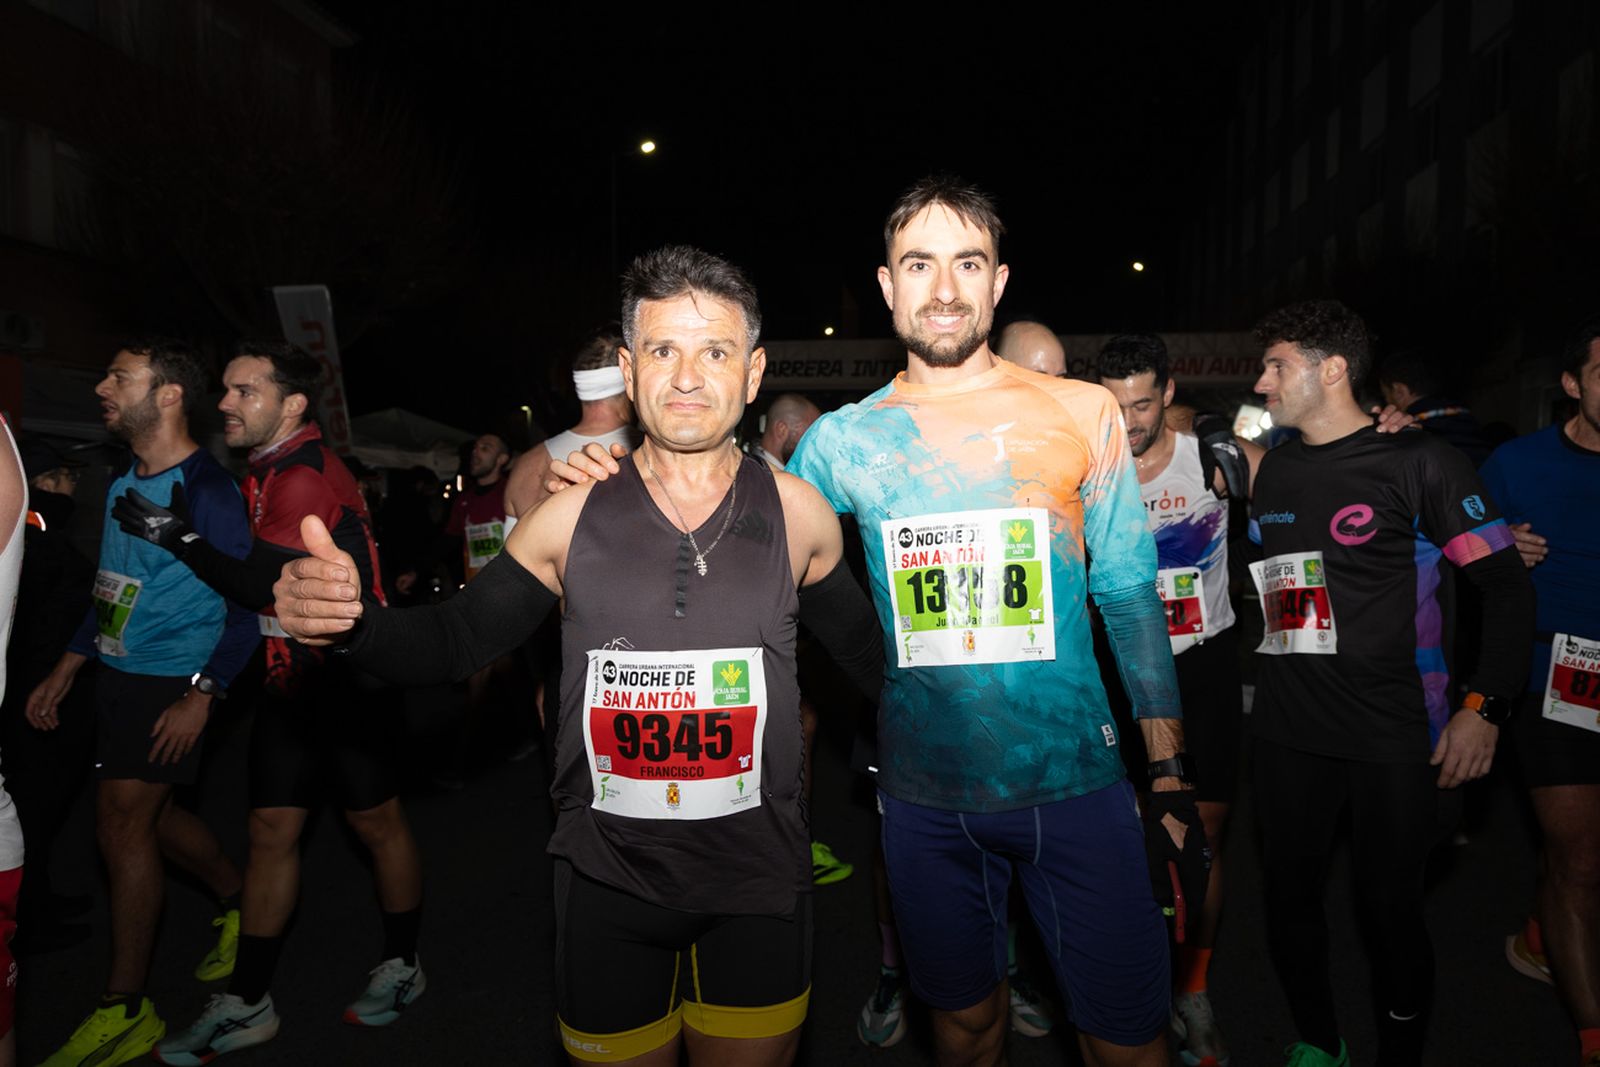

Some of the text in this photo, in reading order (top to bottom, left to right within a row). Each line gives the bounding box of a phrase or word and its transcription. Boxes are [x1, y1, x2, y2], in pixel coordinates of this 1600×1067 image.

[767, 360, 843, 377] ARRERA
[1207, 356, 1263, 375] ANT
[1144, 489, 1186, 512] rón
[899, 531, 913, 544] 43
[916, 530, 963, 548] NOCHE
[901, 550, 929, 569] SAN
[602, 665, 617, 678] 43
[1562, 656, 1586, 669] SAN
[618, 671, 695, 687] NOCHE DE
[602, 686, 696, 709] SAN ANTÓN
[613, 712, 734, 763] 9345
[640, 766, 705, 778] FRANCISCO
